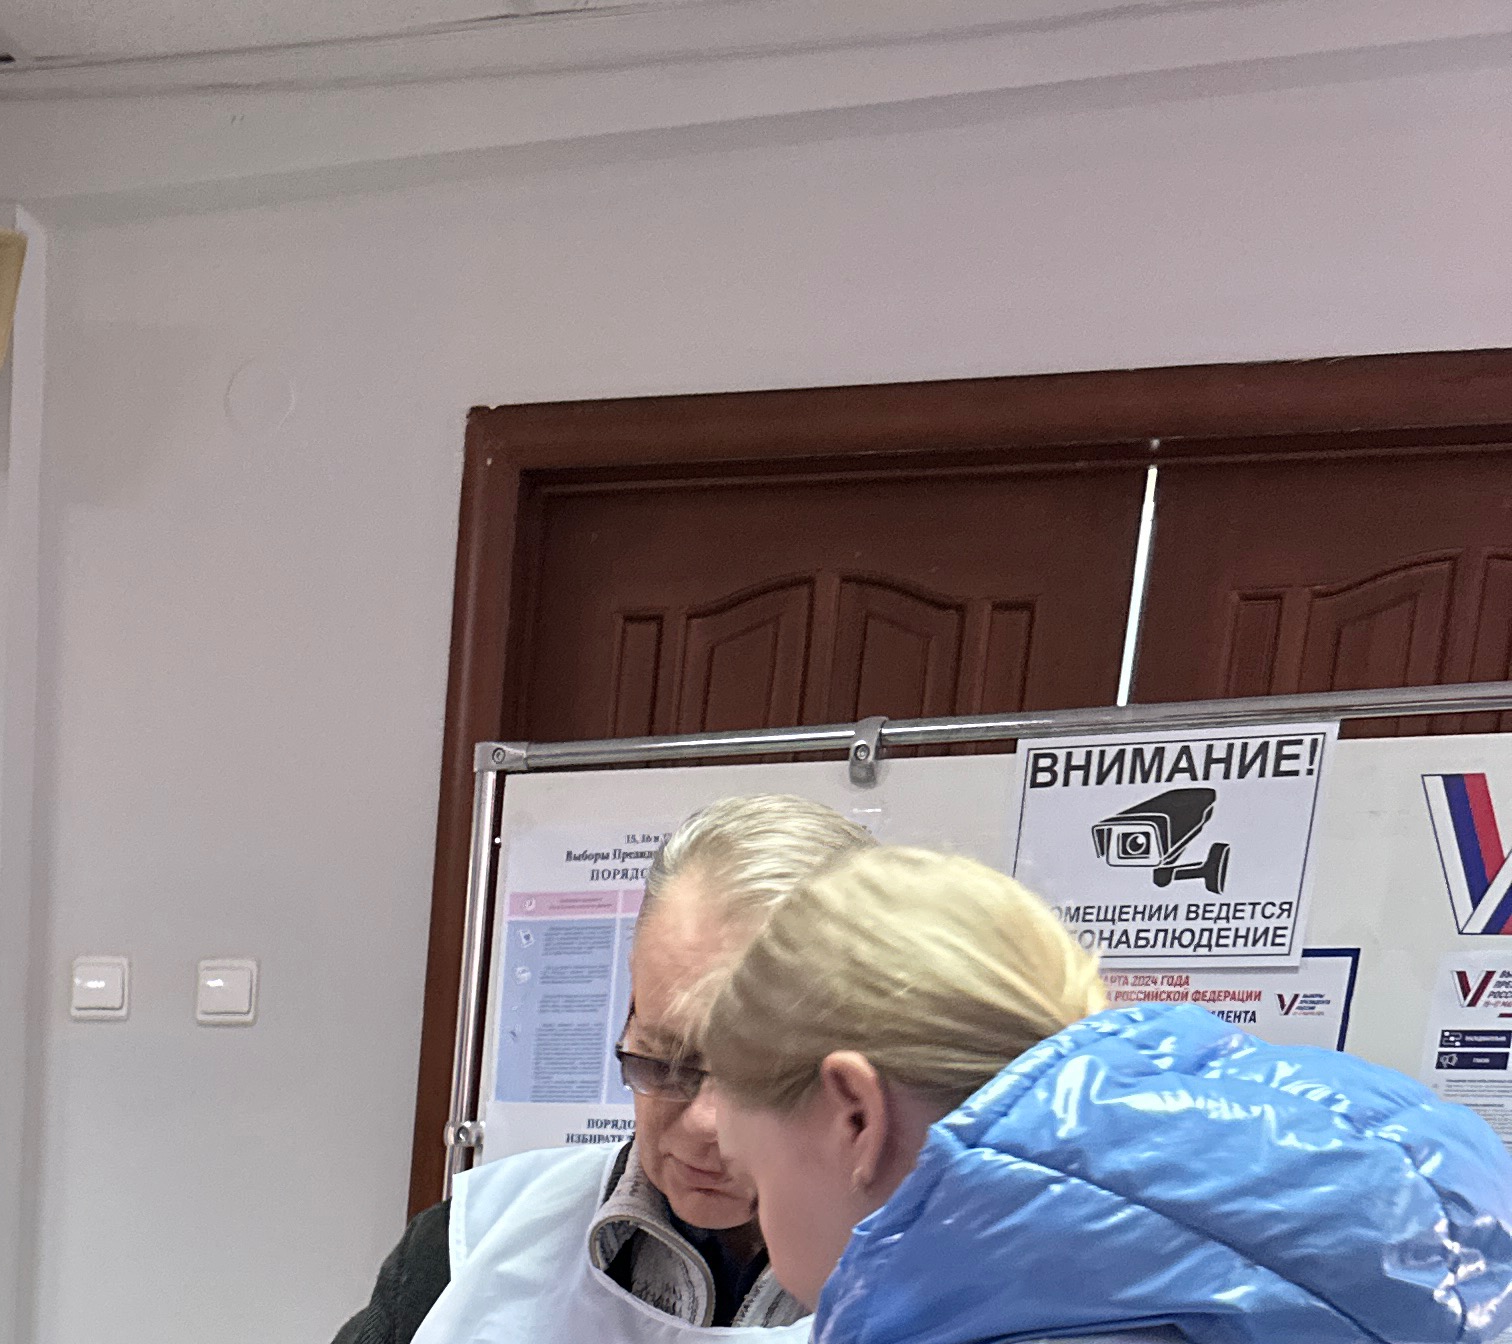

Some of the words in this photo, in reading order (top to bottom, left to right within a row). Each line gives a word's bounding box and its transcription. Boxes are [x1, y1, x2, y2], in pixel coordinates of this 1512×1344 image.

[1029, 738, 1319, 788] ВНИМАНИЕ!
[565, 849, 610, 864] Выборы
[1185, 901, 1294, 924] ВЕДЕТСЯ
[1068, 926, 1290, 952] ОНАБЛЮДЕНИЕ
[1130, 974, 1158, 987] 2024
[1160, 974, 1190, 988] ГОДА
[1114, 987, 1189, 1001] РОССИЙСКОЙ
[1191, 989, 1263, 1003] ФЕДЕРАЦИИ
[1212, 1010, 1257, 1023] ДЕНТА
